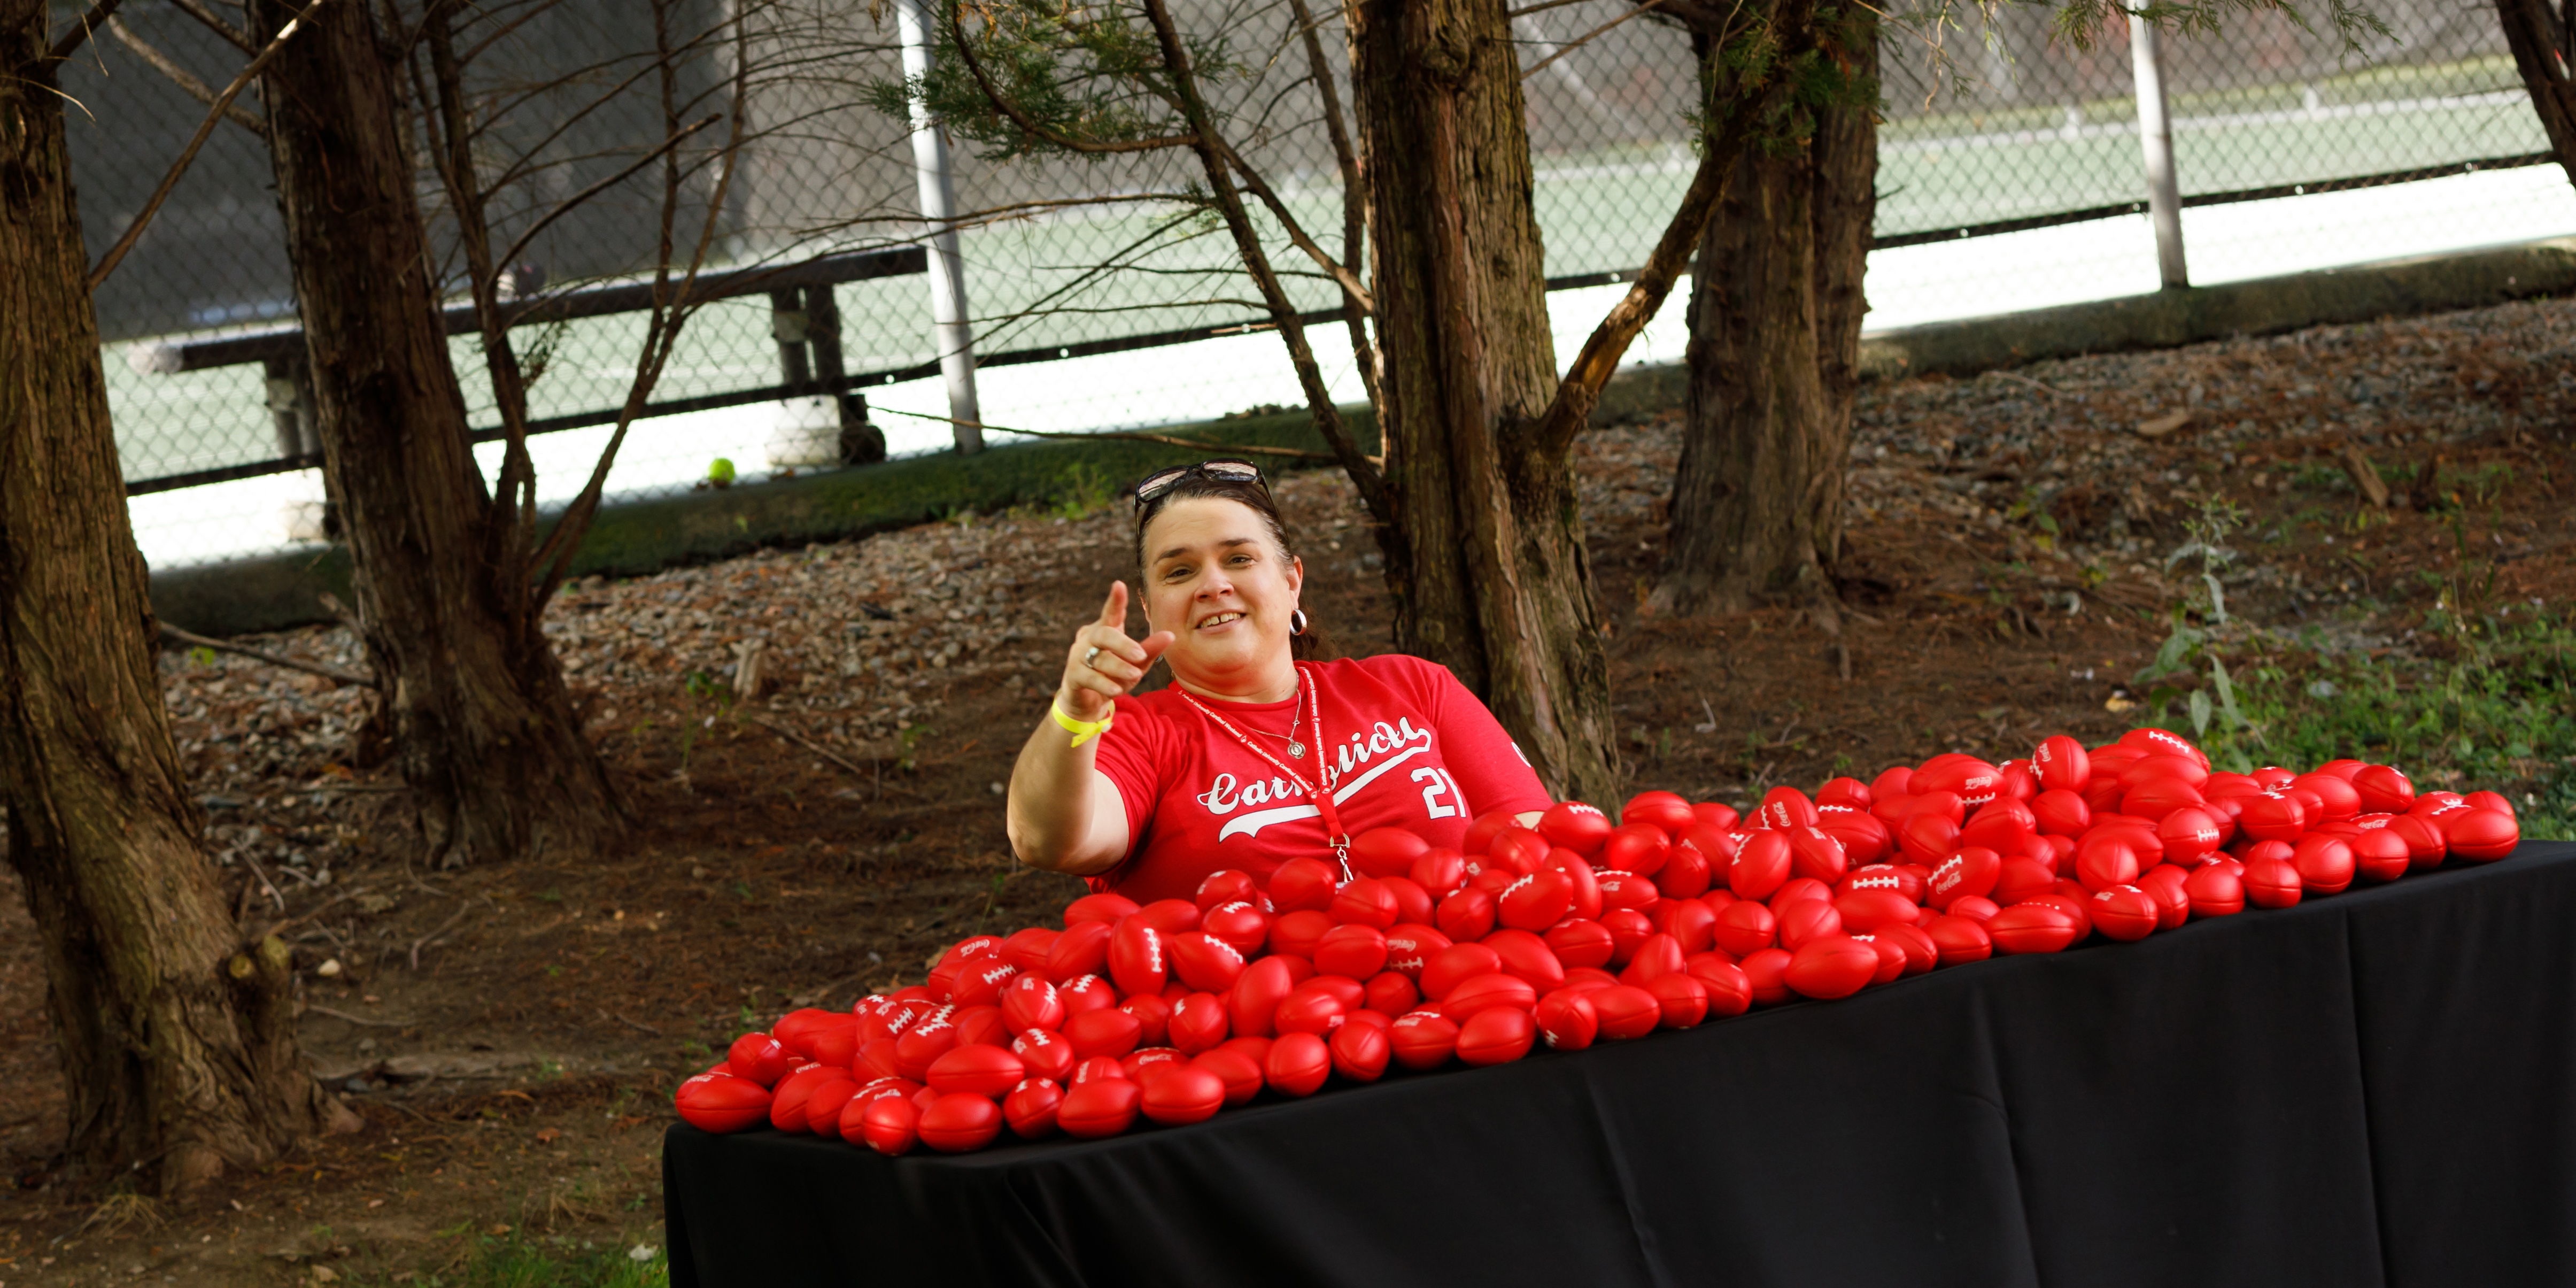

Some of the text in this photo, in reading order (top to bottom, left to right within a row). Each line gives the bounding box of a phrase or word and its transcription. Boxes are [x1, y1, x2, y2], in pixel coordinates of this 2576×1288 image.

[1209, 712, 1226, 724] Cardinal
[1224, 722, 1243, 738] Weekend
[1247, 741, 1313, 791] Catholic University Cardinal Weekend
